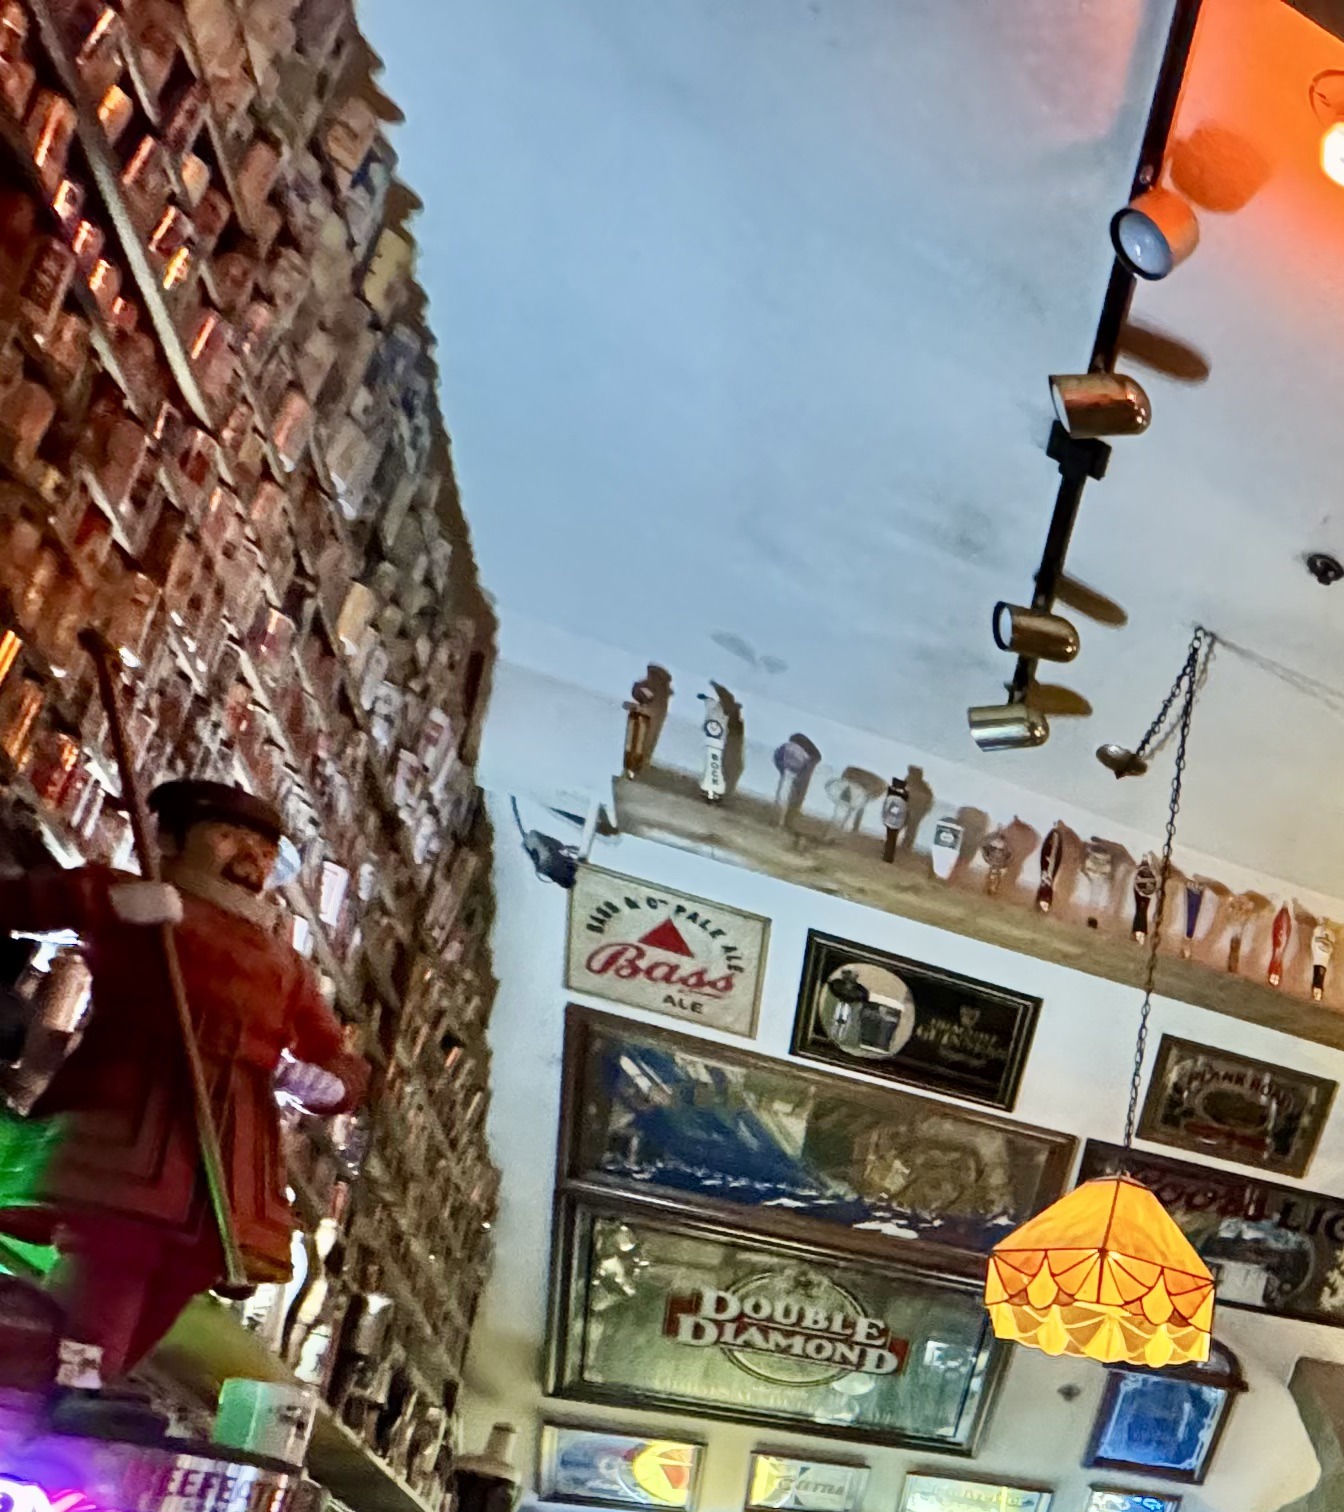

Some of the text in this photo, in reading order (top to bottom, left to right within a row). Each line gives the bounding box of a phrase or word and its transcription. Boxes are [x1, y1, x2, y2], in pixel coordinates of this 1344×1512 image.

[585, 942, 735, 993] Bass
[663, 994, 704, 1015] ALE
[676, 1312, 900, 1376] DIAMOND
[700, 1285, 887, 1347] DOUBLE
